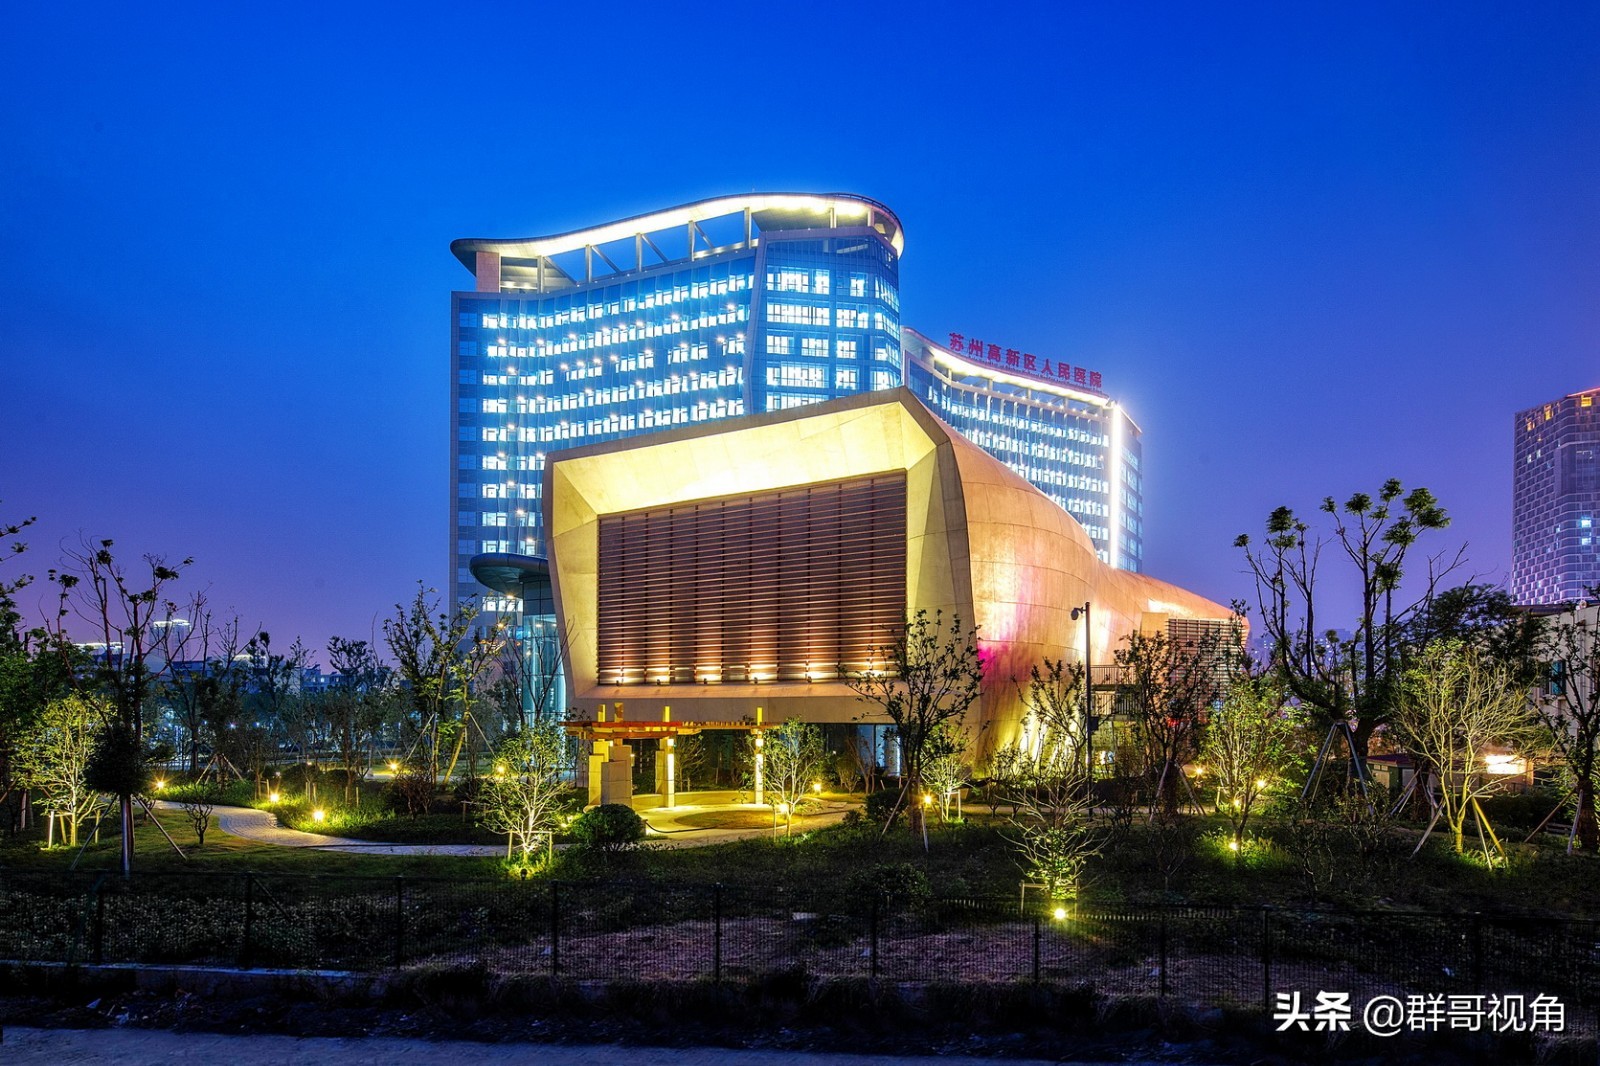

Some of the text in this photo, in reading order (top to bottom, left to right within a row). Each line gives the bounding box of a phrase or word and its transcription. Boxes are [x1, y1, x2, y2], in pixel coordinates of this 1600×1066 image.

[949, 332, 1102, 388] 苏州高新区人民医院
